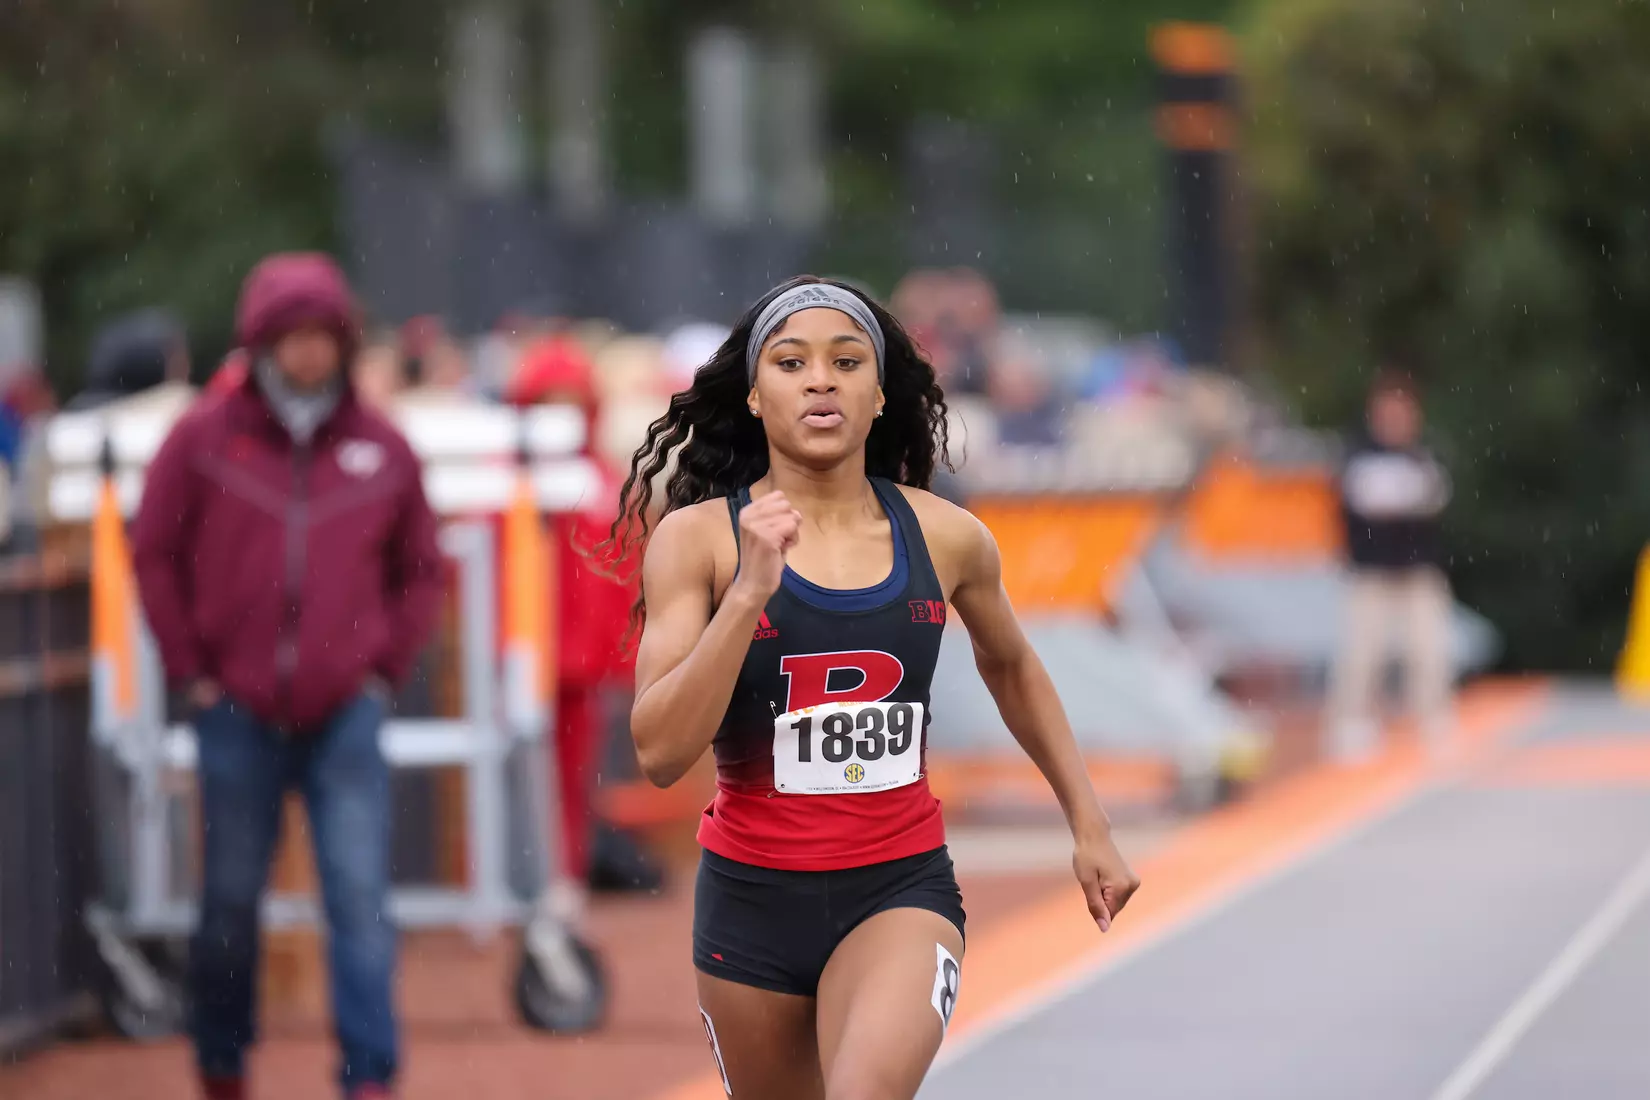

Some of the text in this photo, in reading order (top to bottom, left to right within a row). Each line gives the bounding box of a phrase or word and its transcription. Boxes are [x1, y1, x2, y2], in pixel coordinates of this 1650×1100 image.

[753, 628, 778, 641] das
[791, 703, 914, 763] 1839
[845, 764, 865, 783] SEC
[940, 958, 958, 1027] 8
